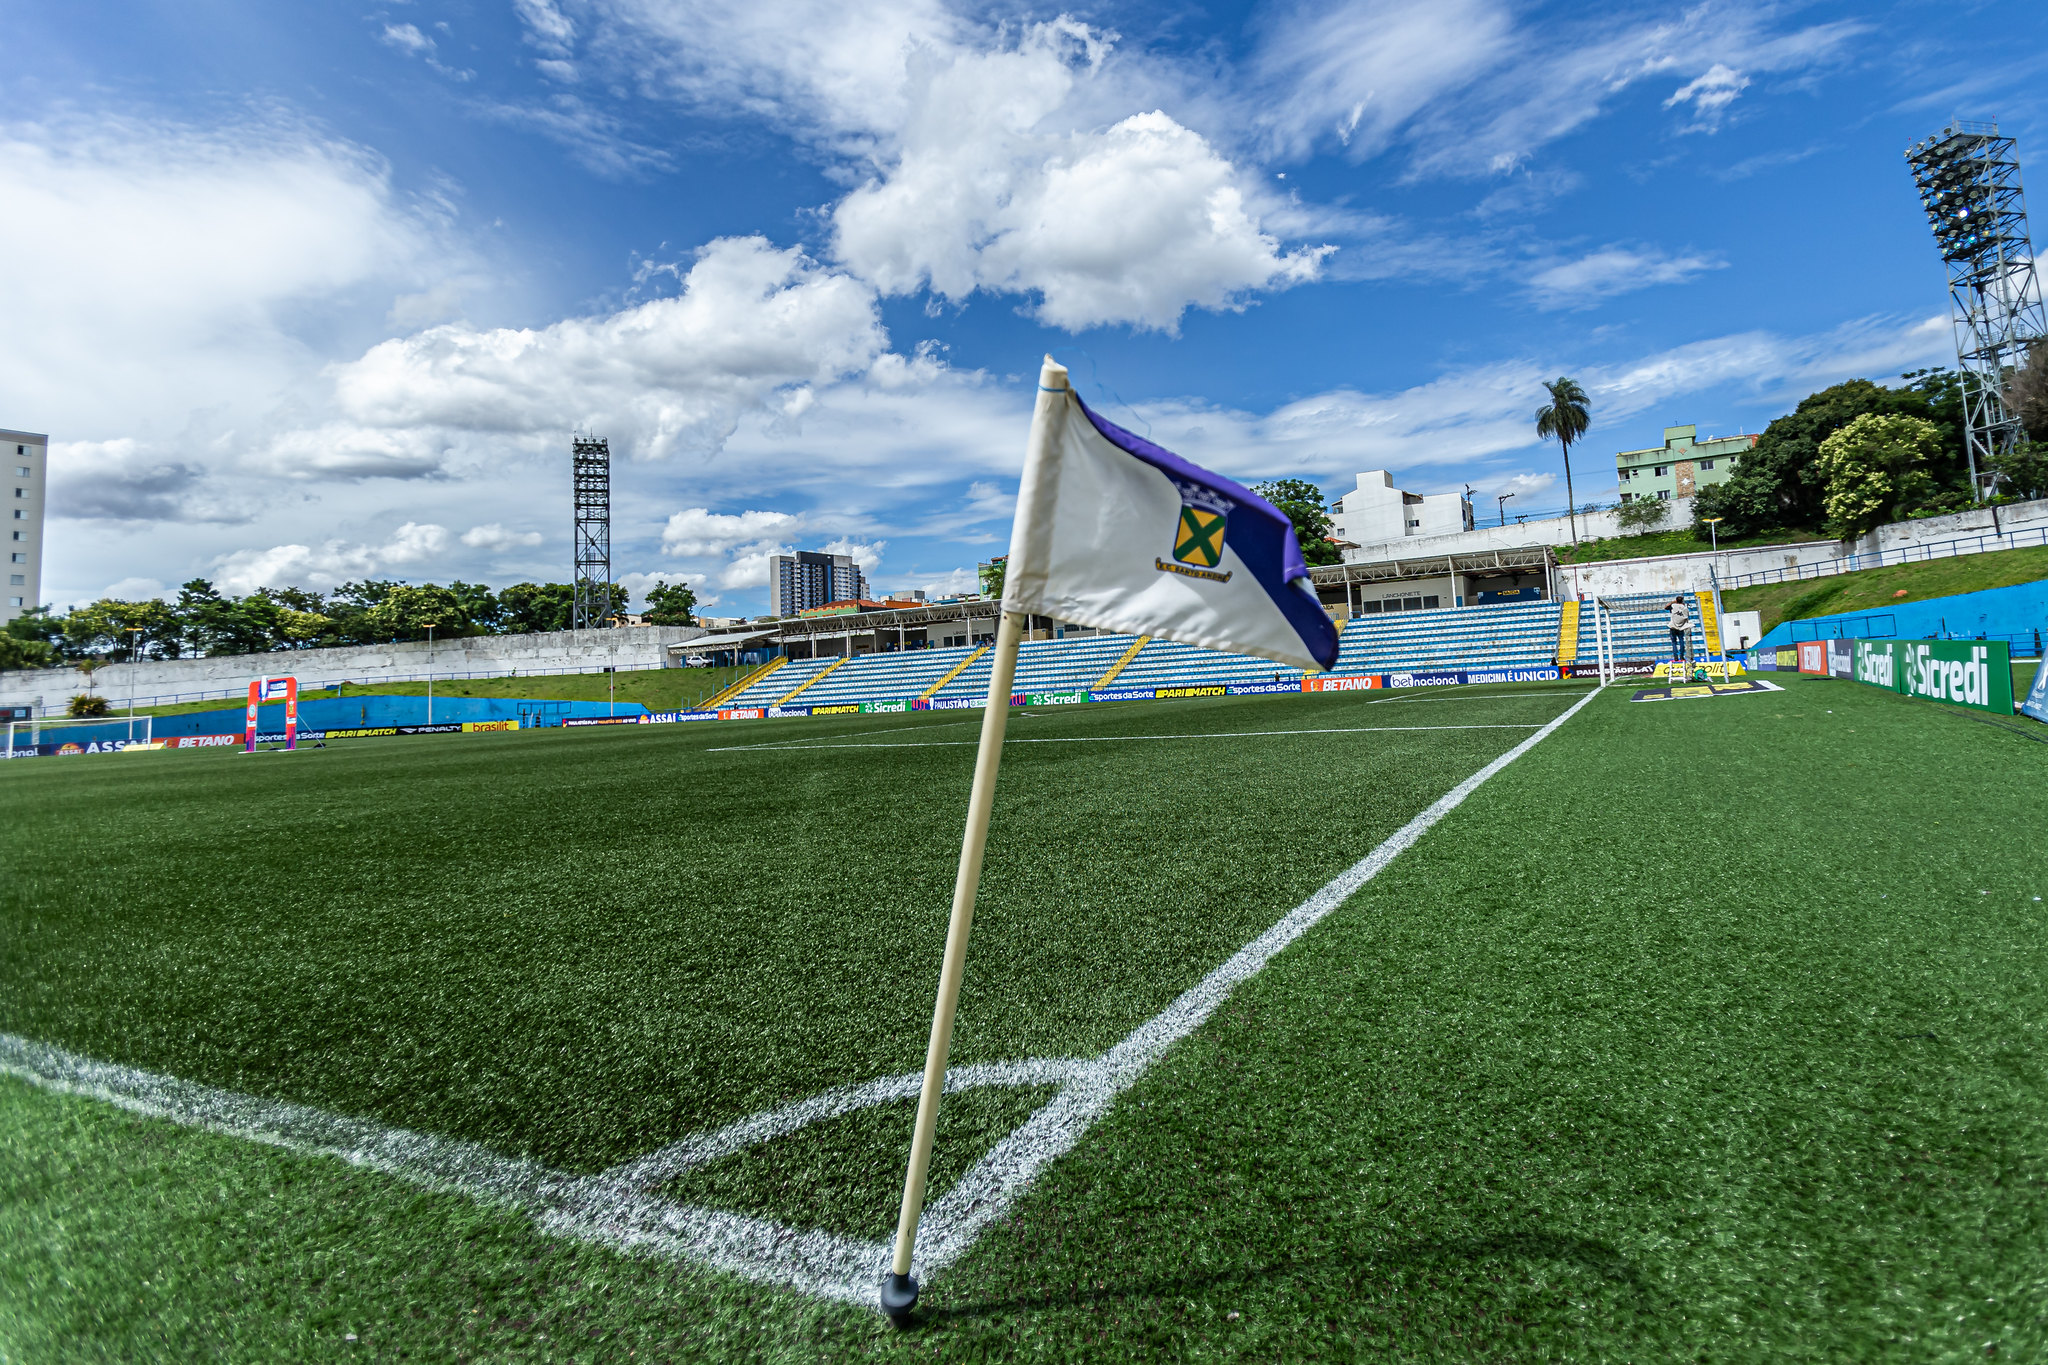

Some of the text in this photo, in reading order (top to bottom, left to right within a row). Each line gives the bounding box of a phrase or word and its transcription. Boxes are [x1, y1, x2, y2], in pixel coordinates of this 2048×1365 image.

[1864, 642, 1893, 687] Sicredi
[1468, 670, 1558, 684] MEDICINA É UNICID
[1917, 644, 1989, 706] Sicredi
[1227, 682, 1301, 695] Esportes da Sorte
[1322, 678, 1372, 691] BETANO
[1043, 692, 1082, 705] Sicredi
[1089, 690, 1154, 702] Esportes da Sorte
[873, 702, 906, 713] Sicredi
[934, 698, 969, 709] PAULISTÃO
[650, 712, 677, 723] ASSAÍ
[730, 709, 759, 719] BETANO
[418, 725, 461, 733] PENALTY
[473, 721, 509, 732] brasilit
[178, 735, 235, 748] BETANO
[255, 733, 288, 742] sportes
[300, 731, 325, 740] Sorte
